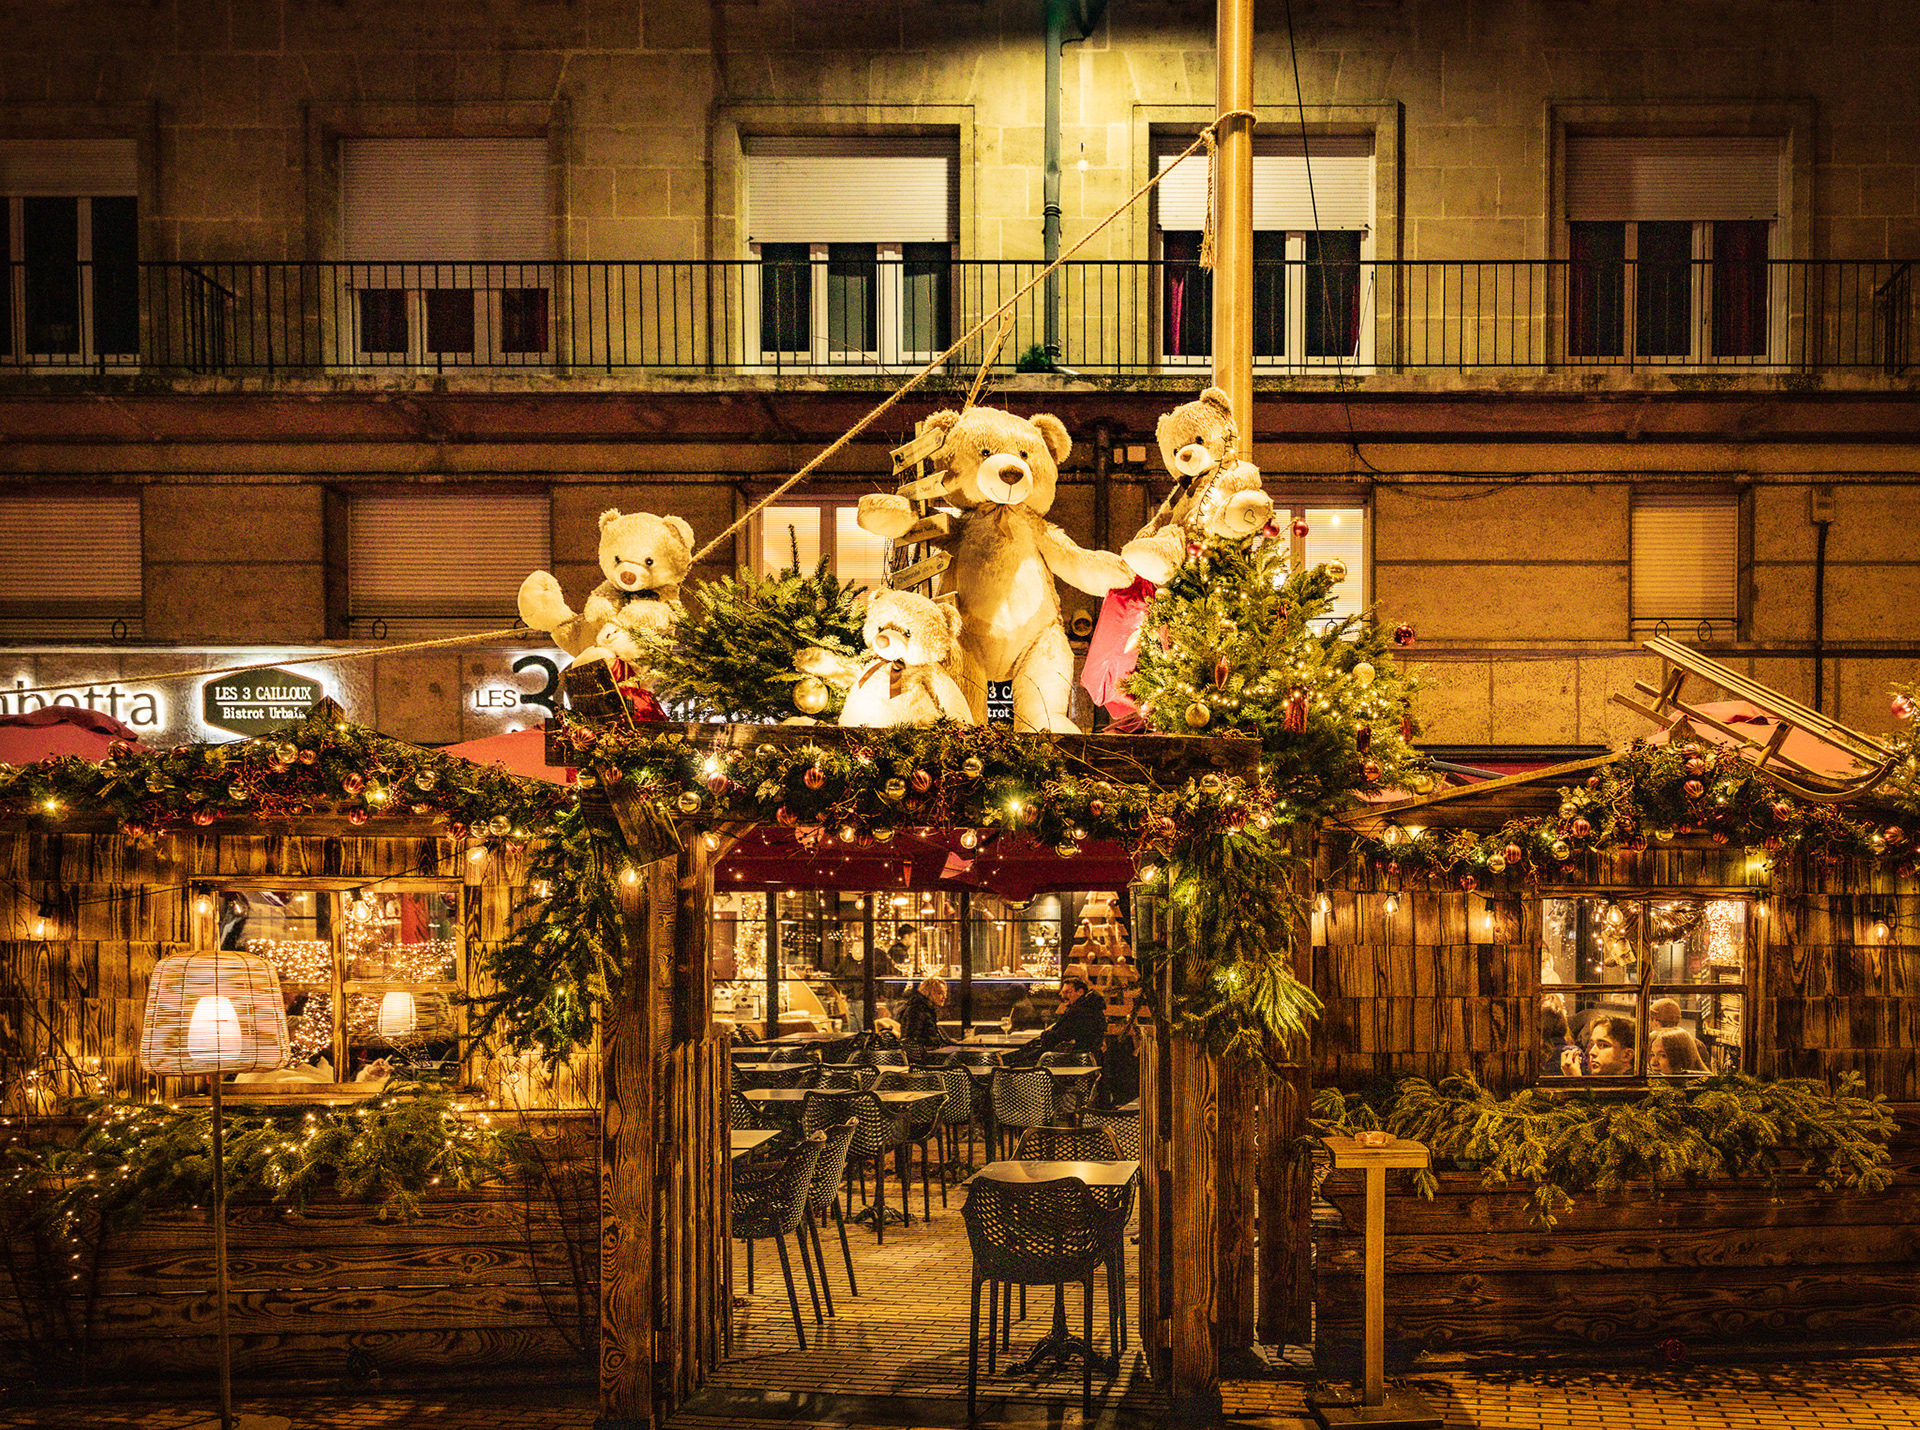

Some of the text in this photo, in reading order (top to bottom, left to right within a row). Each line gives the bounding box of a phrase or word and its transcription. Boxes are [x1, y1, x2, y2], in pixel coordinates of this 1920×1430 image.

[215, 686, 312, 701] LES 3 CAILLOUX
[475, 654, 559, 733] LES 3
[988, 686, 997, 699] 3
[0, 680, 158, 726] btta
[222, 706, 265, 719] Bistrot
[987, 707, 1010, 718] trot
